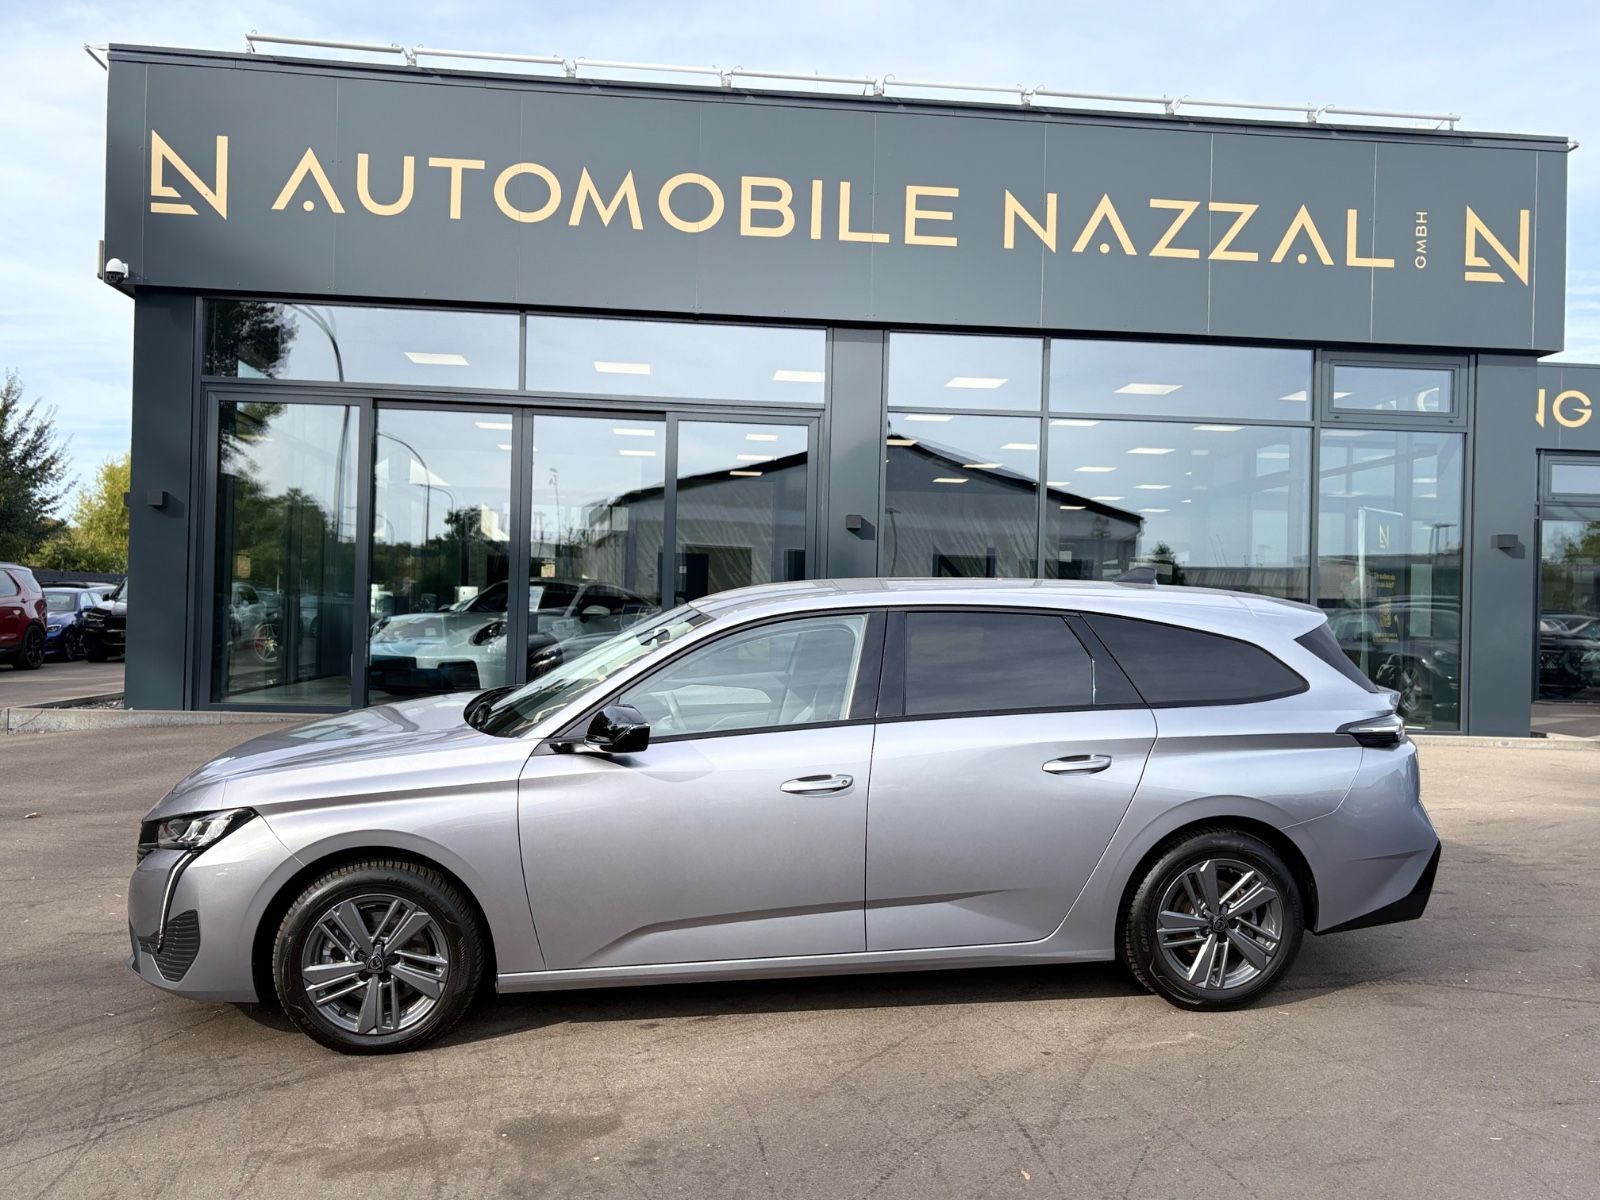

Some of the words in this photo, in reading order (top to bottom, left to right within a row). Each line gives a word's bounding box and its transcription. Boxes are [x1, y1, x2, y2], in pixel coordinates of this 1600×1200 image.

[271, 148, 961, 248] AUTOMOBILE
[1003, 189, 1395, 270] NAZZAL
[1415, 211, 1428, 269] GMBH
